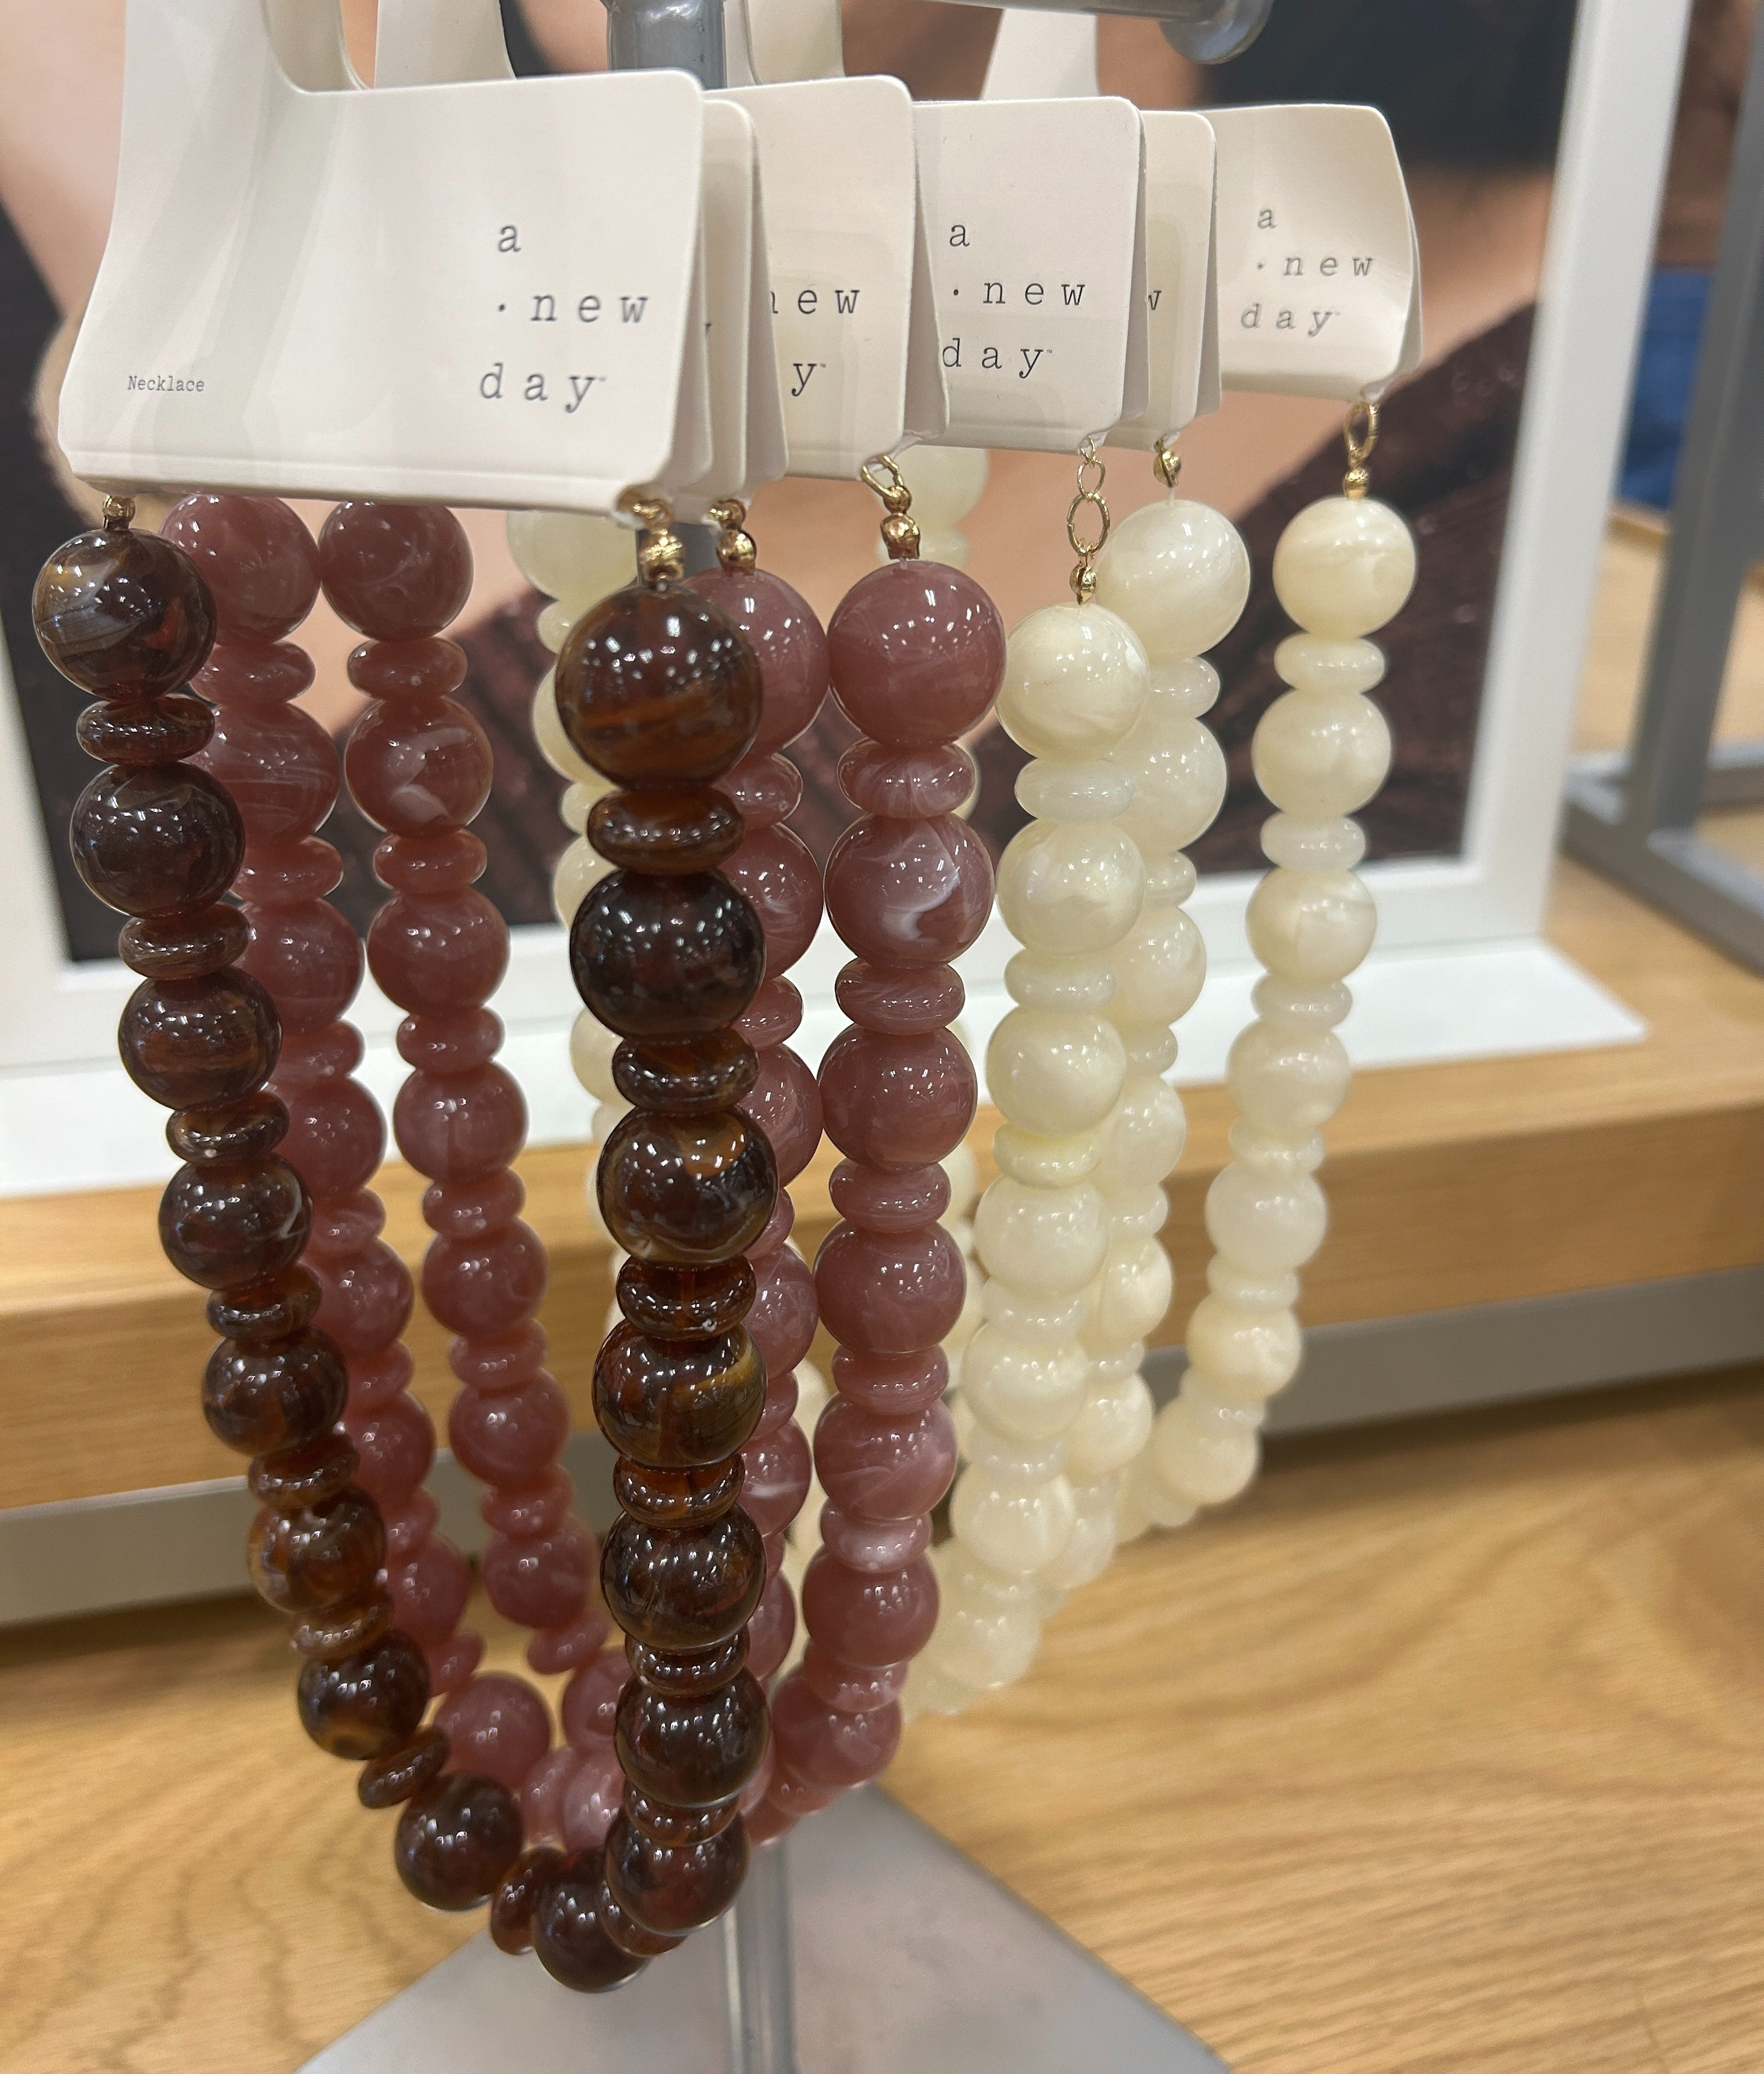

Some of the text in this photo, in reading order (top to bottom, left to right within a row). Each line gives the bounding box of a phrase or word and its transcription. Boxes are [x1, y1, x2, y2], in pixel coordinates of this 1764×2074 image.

[1256, 208, 1277, 230] a
[496, 224, 523, 254] a
[949, 224, 971, 248] a
[127, 374, 205, 392] Necklace
